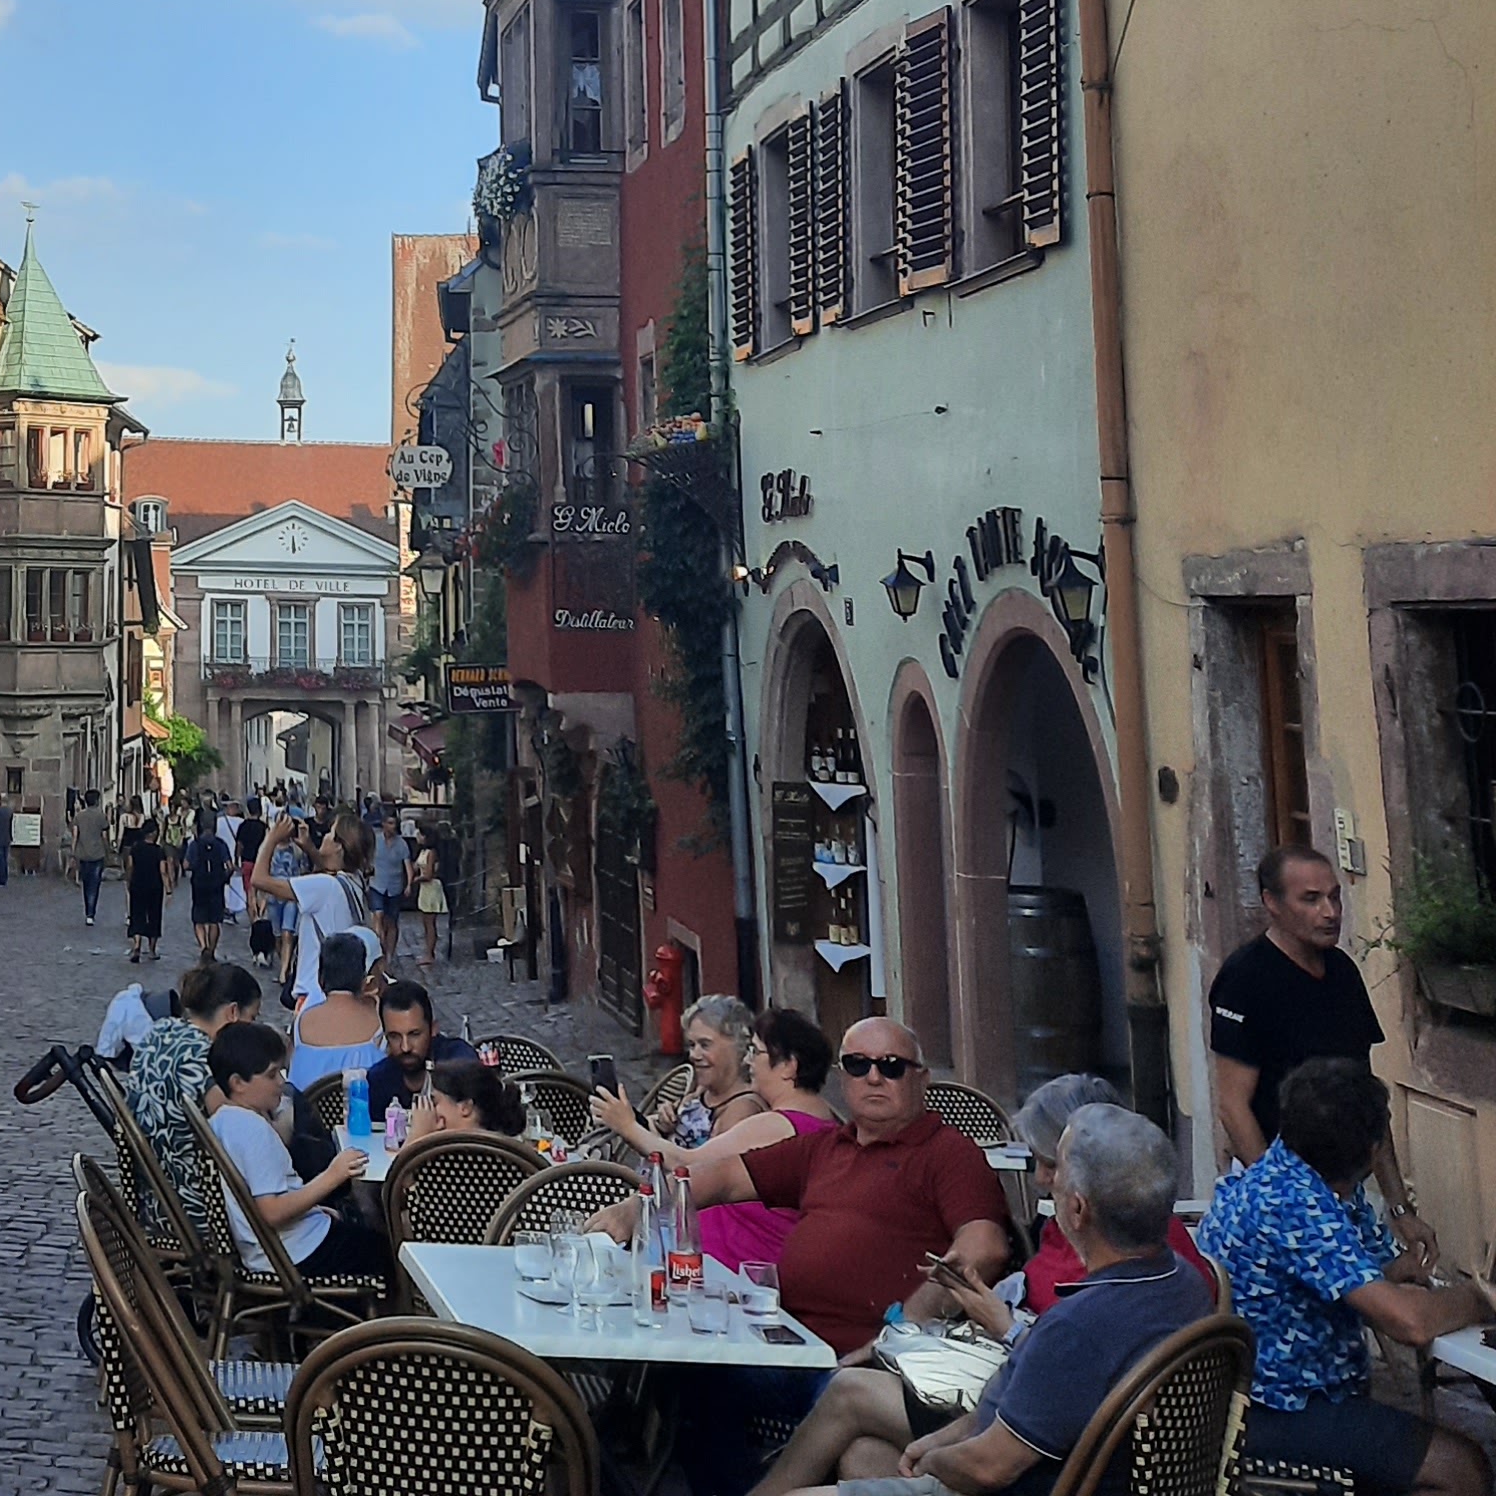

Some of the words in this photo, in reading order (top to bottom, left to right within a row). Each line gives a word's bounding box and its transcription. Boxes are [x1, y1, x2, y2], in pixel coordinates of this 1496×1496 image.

[398, 450, 414, 464] Au
[419, 450, 443, 466] Cep
[396, 469, 410, 482] de
[413, 468, 447, 484] Vigne
[234, 578, 278, 590] HOTEL
[289, 579, 305, 591] DE
[315, 581, 351, 592] VILLE
[554, 609, 635, 630] Distillateur
[453, 685, 508, 698] Dégustat
[474, 697, 508, 708] Vente
